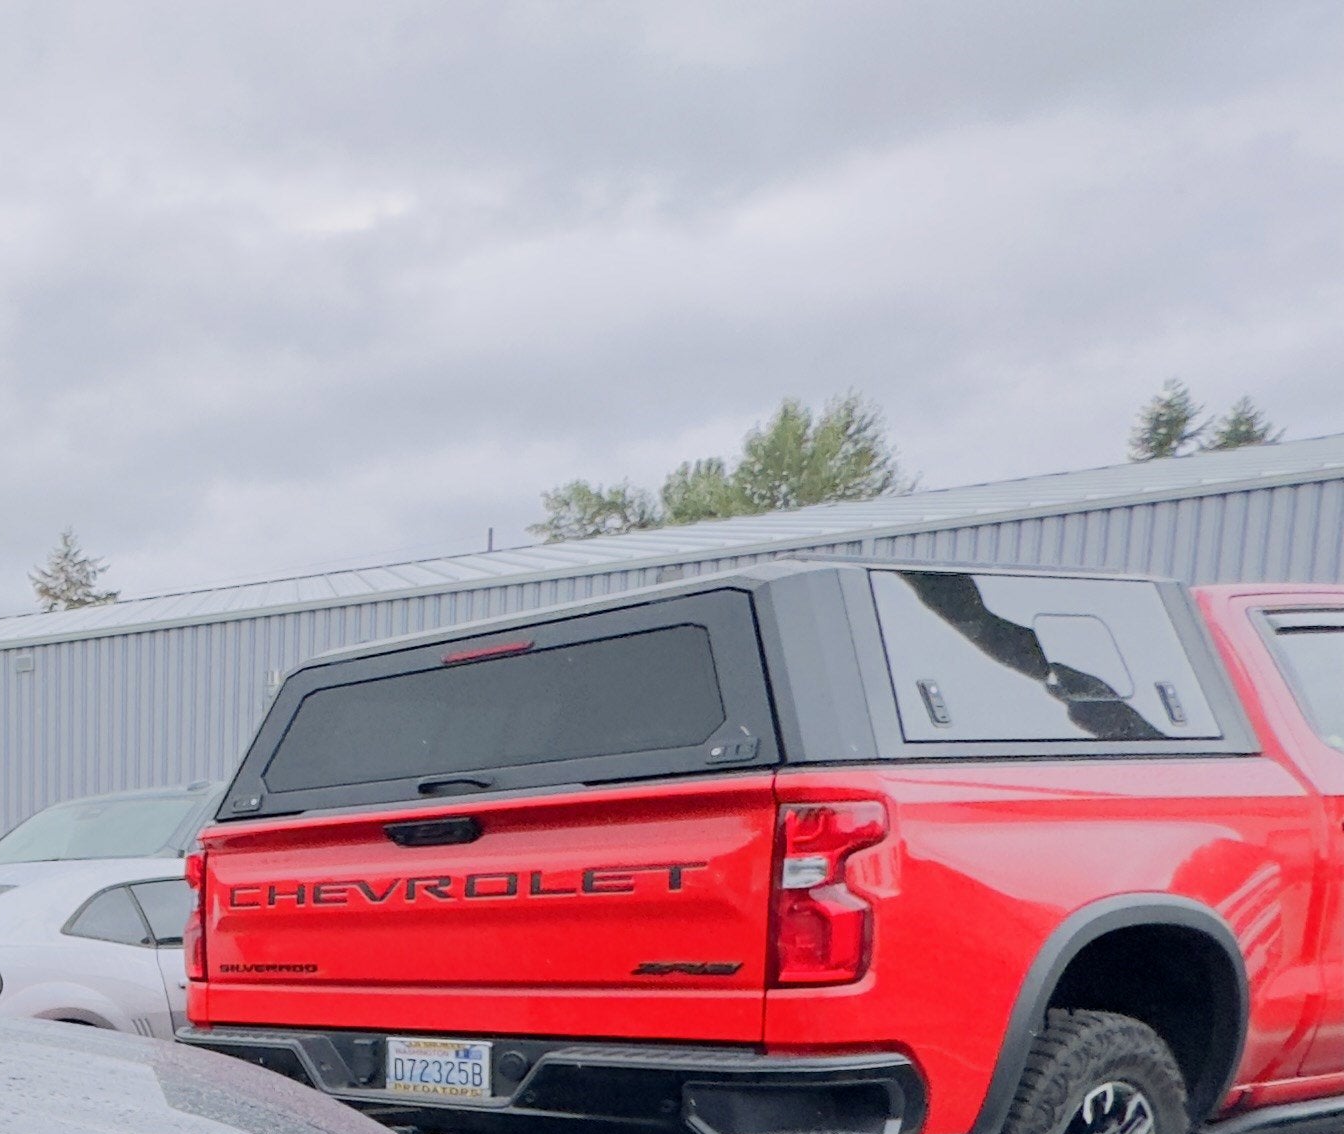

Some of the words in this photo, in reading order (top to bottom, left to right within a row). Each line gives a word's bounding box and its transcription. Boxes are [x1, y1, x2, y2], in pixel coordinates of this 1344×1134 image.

[229, 861, 709, 909] CHEVROLET
[394, 1057, 483, 1087] D72325B
[394, 1082, 480, 1097] PREDATORS
